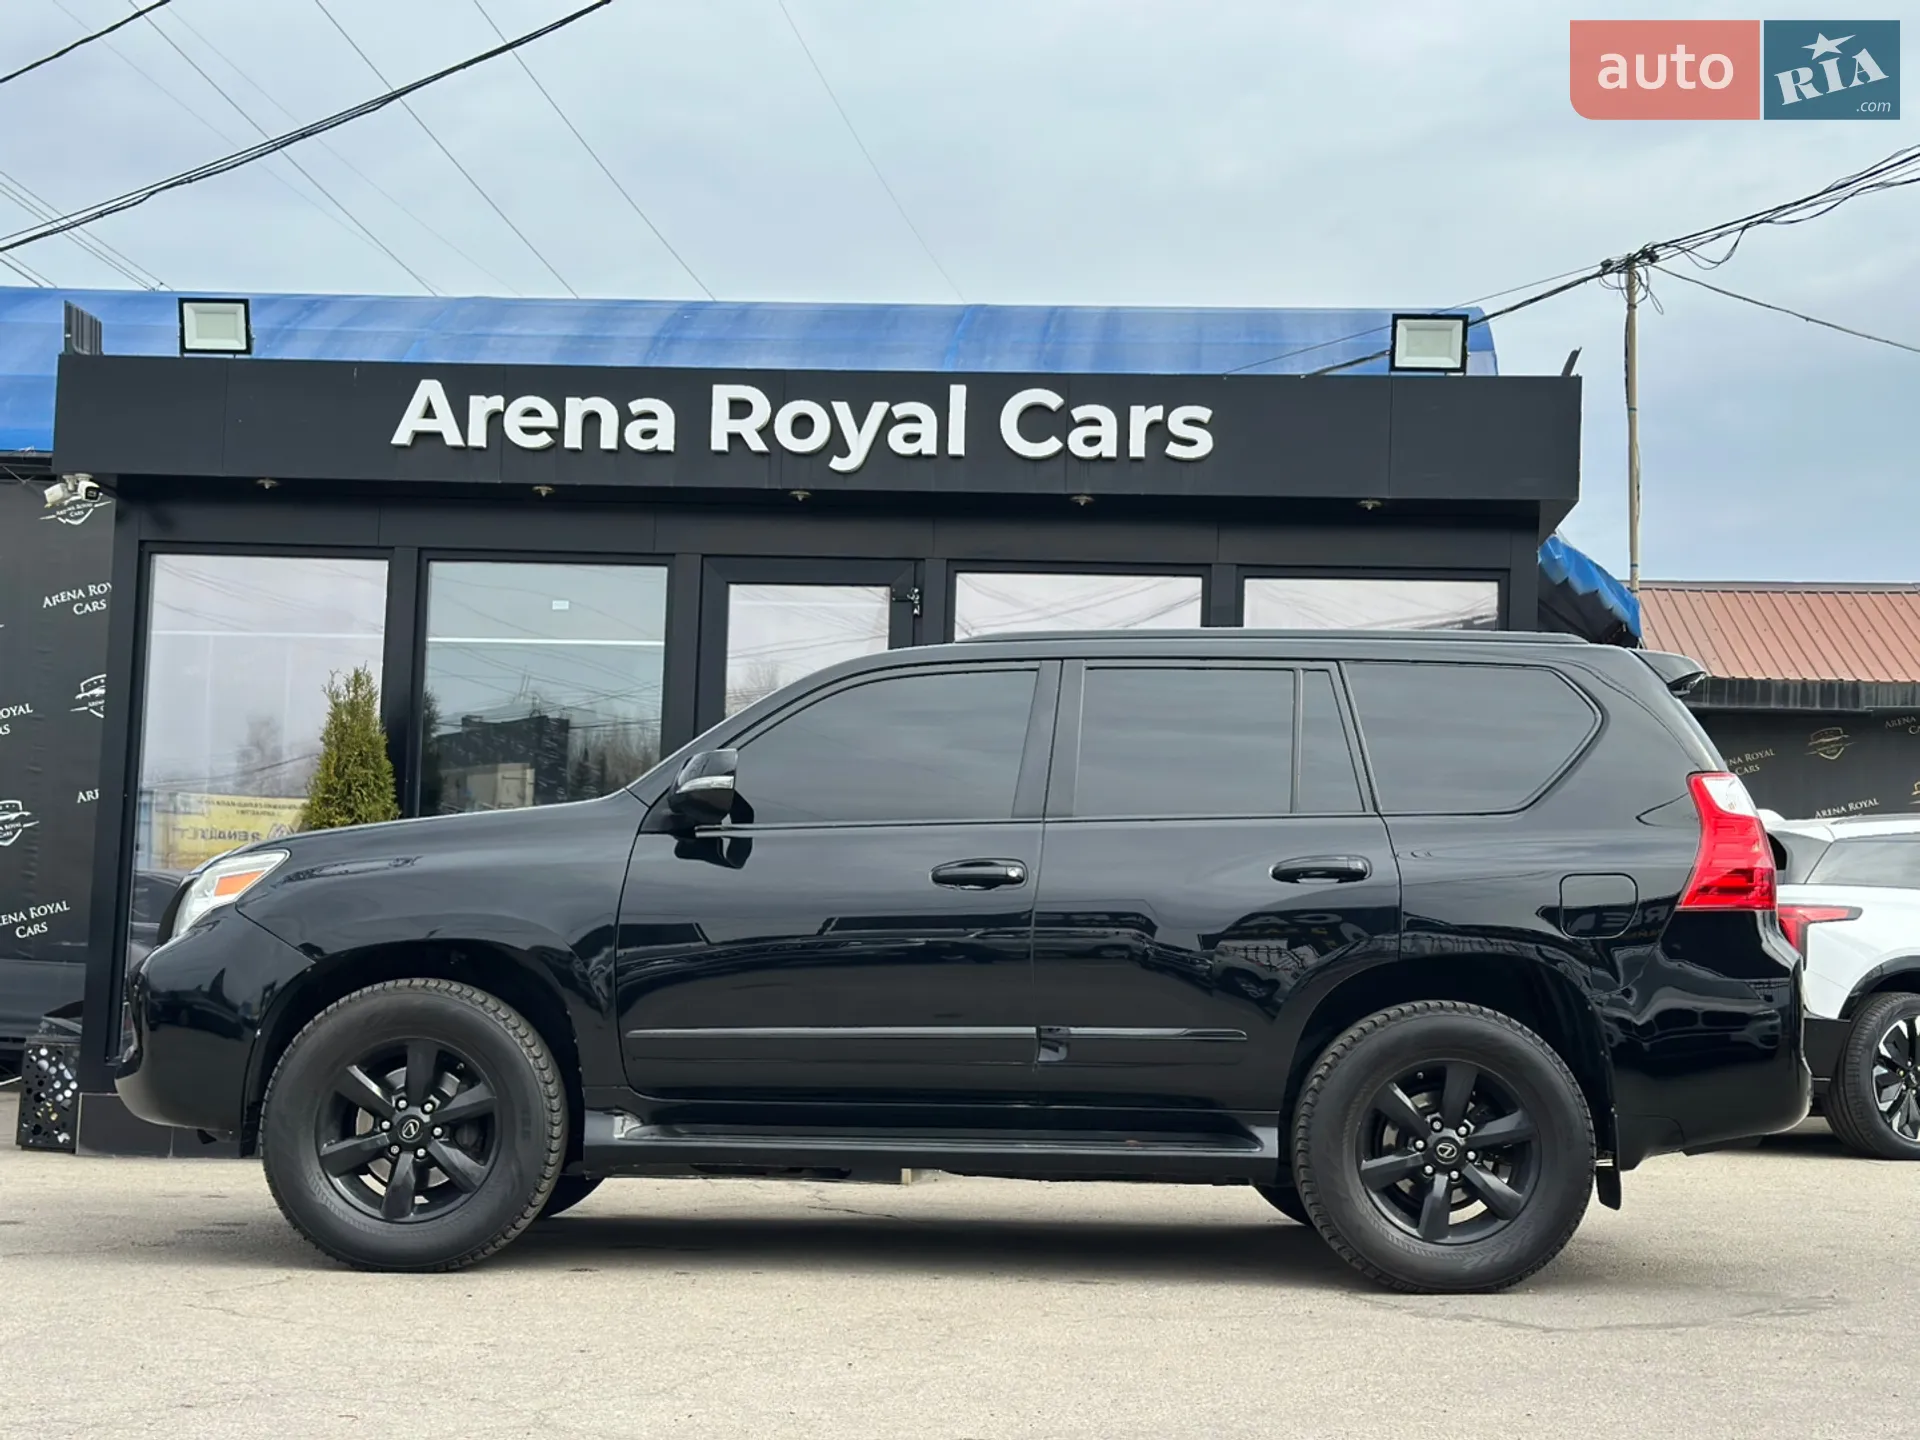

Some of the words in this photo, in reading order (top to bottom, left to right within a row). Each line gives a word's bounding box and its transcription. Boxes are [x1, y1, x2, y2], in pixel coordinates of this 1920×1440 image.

[390, 379, 675, 453] Arena
[711, 384, 967, 473] Royal
[1000, 388, 1214, 461] Cars
[42, 588, 86, 609] ARENA
[72, 599, 107, 615] CARS
[0, 702, 33, 720] OYAL
[1847, 798, 1880, 812] ROYAL
[29, 900, 71, 920] ROYAL
[15, 921, 48, 938] CARS
